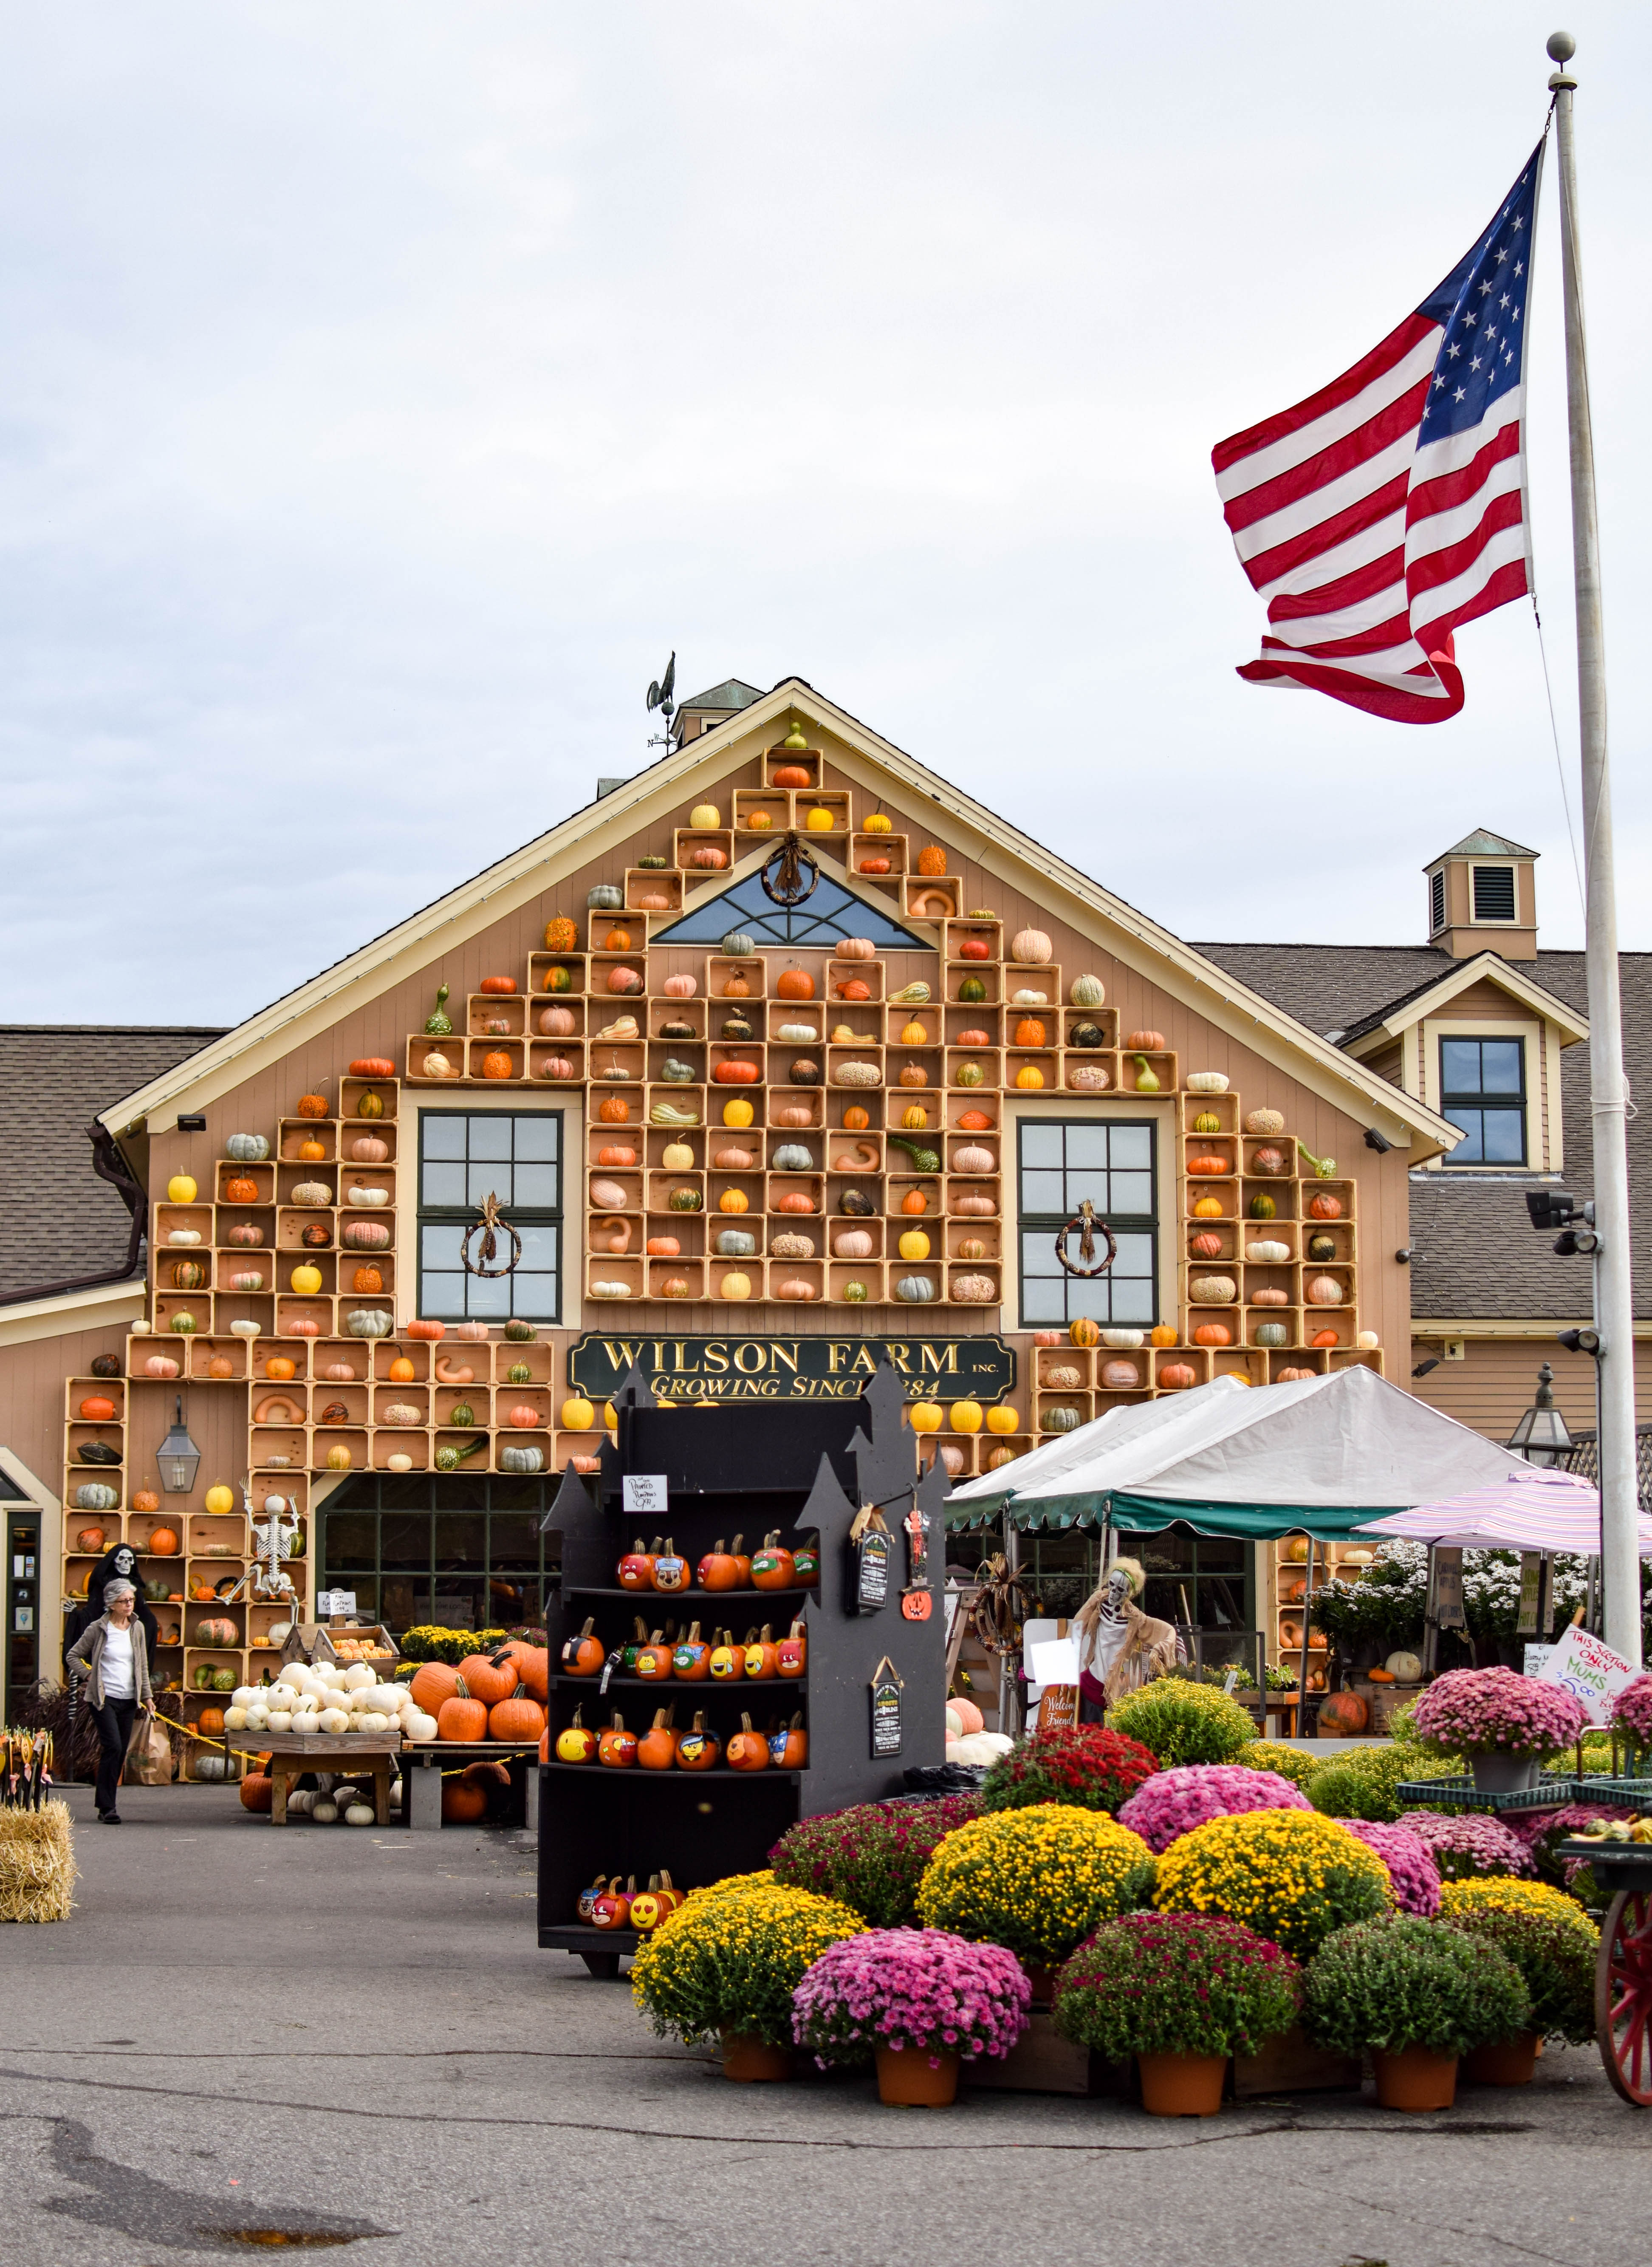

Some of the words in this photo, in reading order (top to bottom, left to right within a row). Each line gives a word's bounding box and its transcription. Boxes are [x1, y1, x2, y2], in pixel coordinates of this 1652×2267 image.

[647, 739, 654, 747] N
[602, 1342, 801, 1374] WILSON
[972, 1364, 999, 1373] INC.
[650, 1375, 781, 1396] GROWING
[629, 1478, 653, 1491] PAINTED
[1567, 1631, 1592, 1648] THIS
[1593, 1645, 1633, 1673] SECTION
[1579, 1650, 1613, 1673] ONLY
[1567, 1655, 1607, 1690] MUMS
[1044, 1695, 1075, 1712] Welcom
